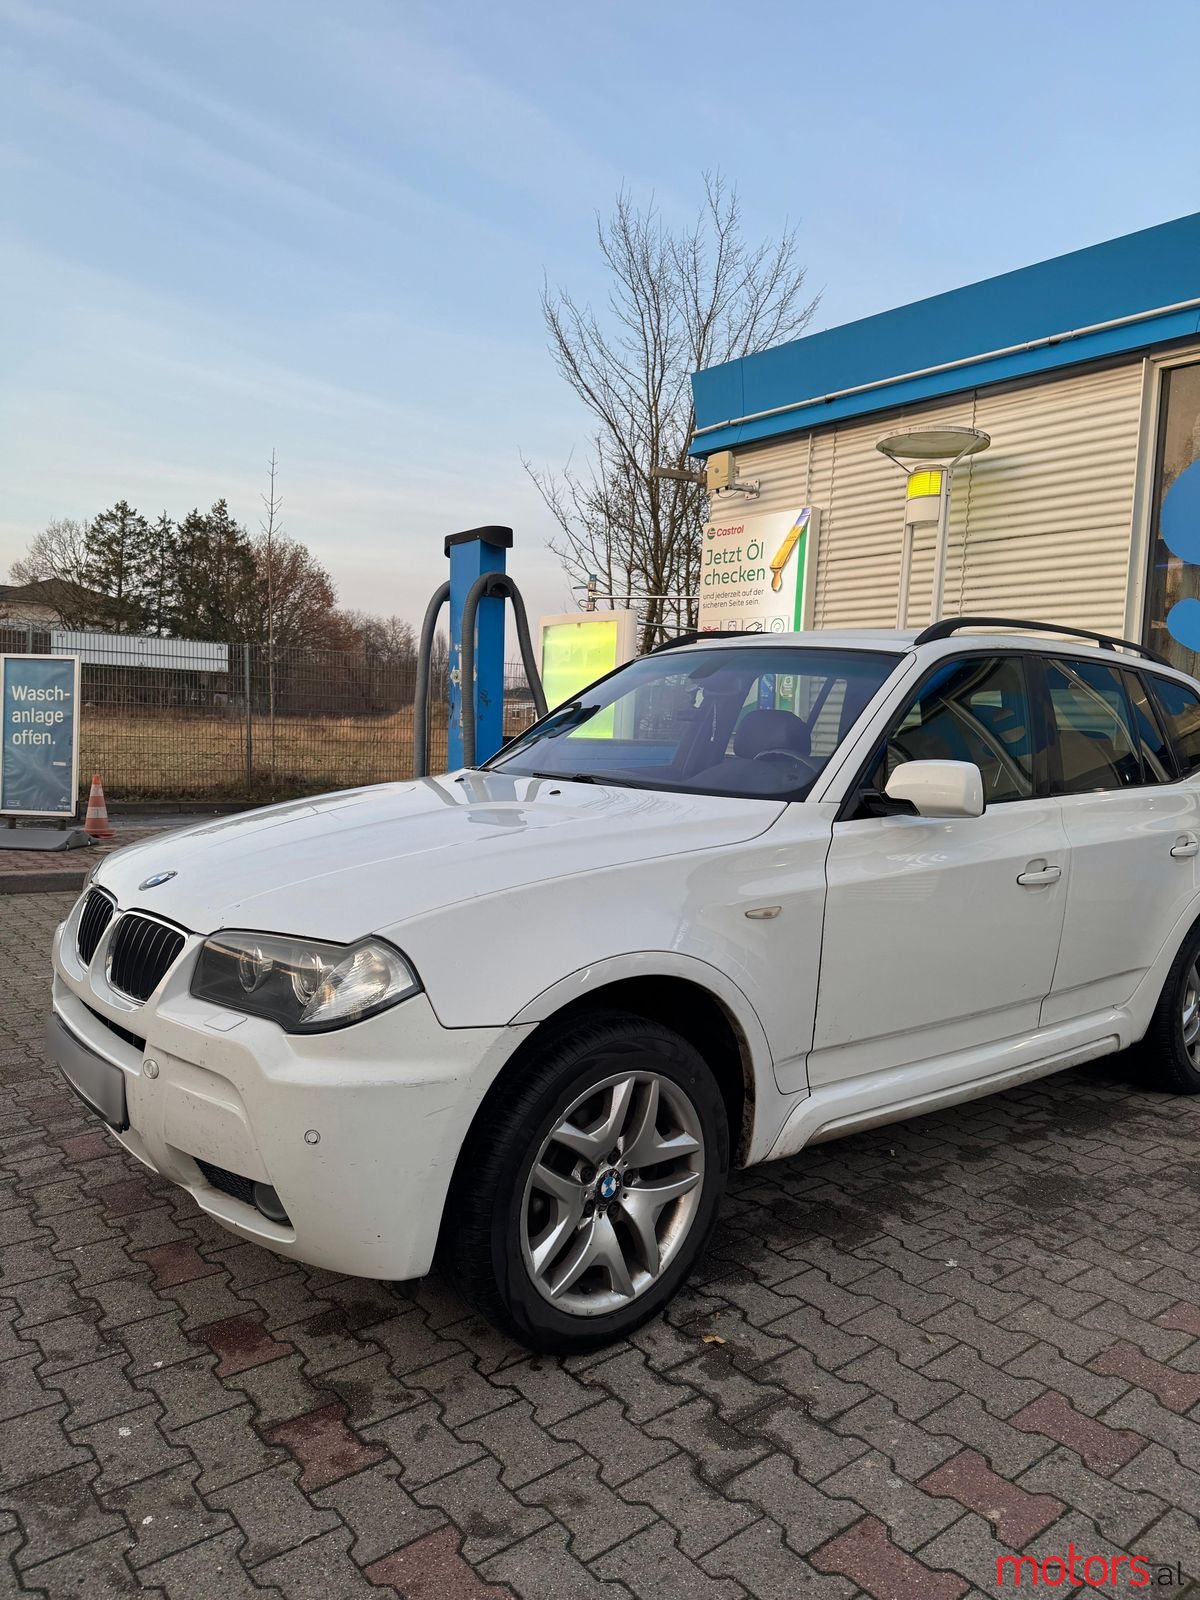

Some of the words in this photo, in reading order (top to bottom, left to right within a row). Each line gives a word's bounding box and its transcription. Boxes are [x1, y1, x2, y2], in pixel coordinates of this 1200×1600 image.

[717, 525, 744, 537] Castrol
[705, 547, 742, 566] Jetzt
[746, 538, 764, 560] Öl
[704, 566, 766, 586] checken
[702, 592, 714, 600] und
[714, 590, 740, 600] jederzeit
[742, 589, 752, 597] auf
[702, 600, 728, 609] sicheren
[729, 599, 744, 608] Seite
[12, 685, 71, 701] Wasch-
[12, 708, 64, 726] anlage
[12, 730, 56, 744] offen.
